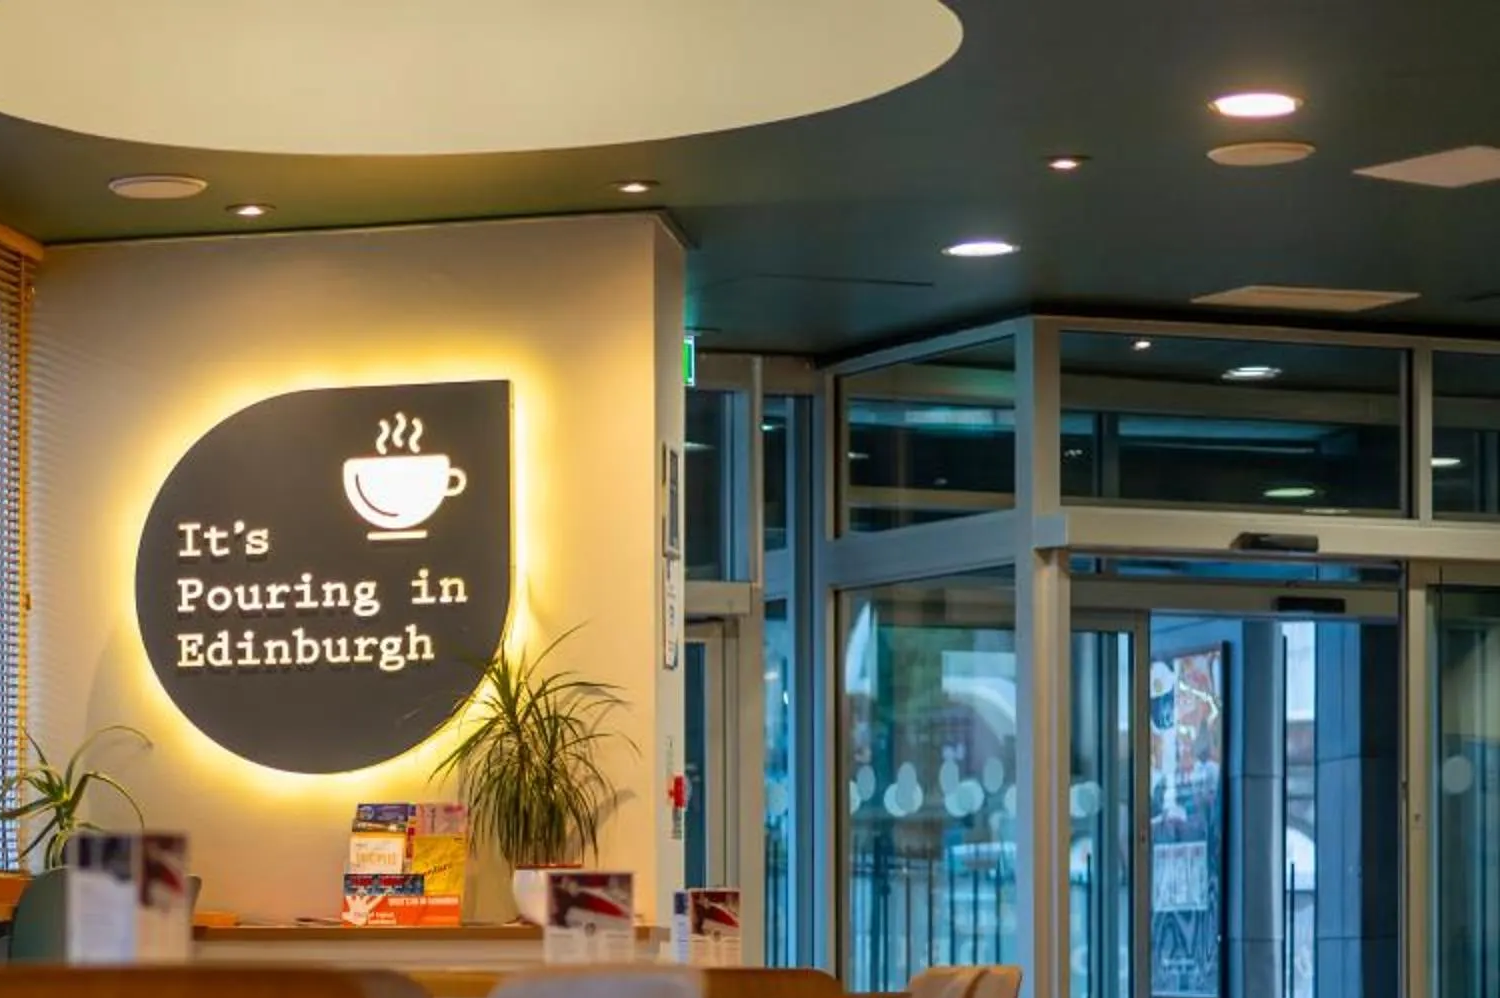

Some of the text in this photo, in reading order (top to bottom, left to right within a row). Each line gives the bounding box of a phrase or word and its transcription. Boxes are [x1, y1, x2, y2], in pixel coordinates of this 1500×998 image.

[178, 520, 269, 557] It's
[177, 569, 468, 617] Pouring in
[177, 624, 435, 671] Edinburgh
